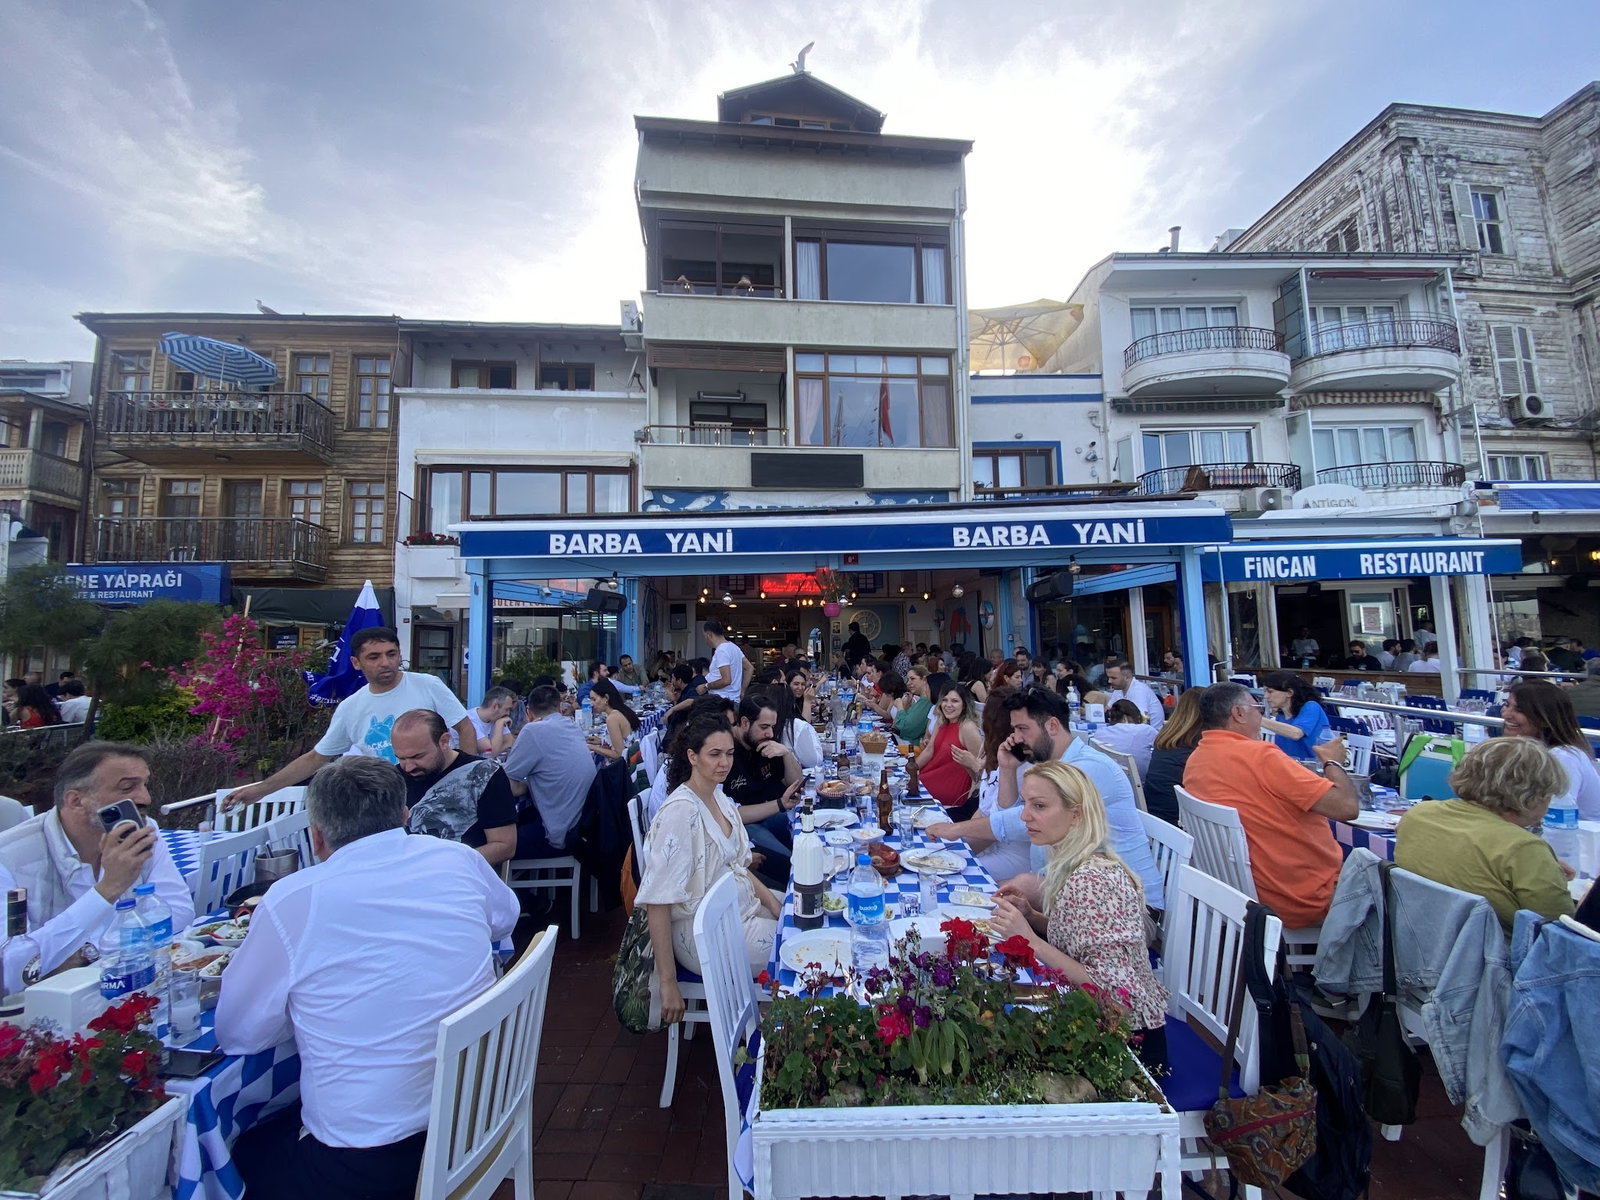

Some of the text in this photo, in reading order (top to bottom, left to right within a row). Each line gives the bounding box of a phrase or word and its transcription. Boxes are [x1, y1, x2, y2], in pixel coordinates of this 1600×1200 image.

[549, 529, 733, 554] BARBA YANİ
[952, 519, 1146, 547] BARBA YANİ
[1360, 551, 1485, 575] RESTAURANT
[103, 570, 182, 589] YAPRAĞI
[97, 590, 154, 599] RESTAURANT
